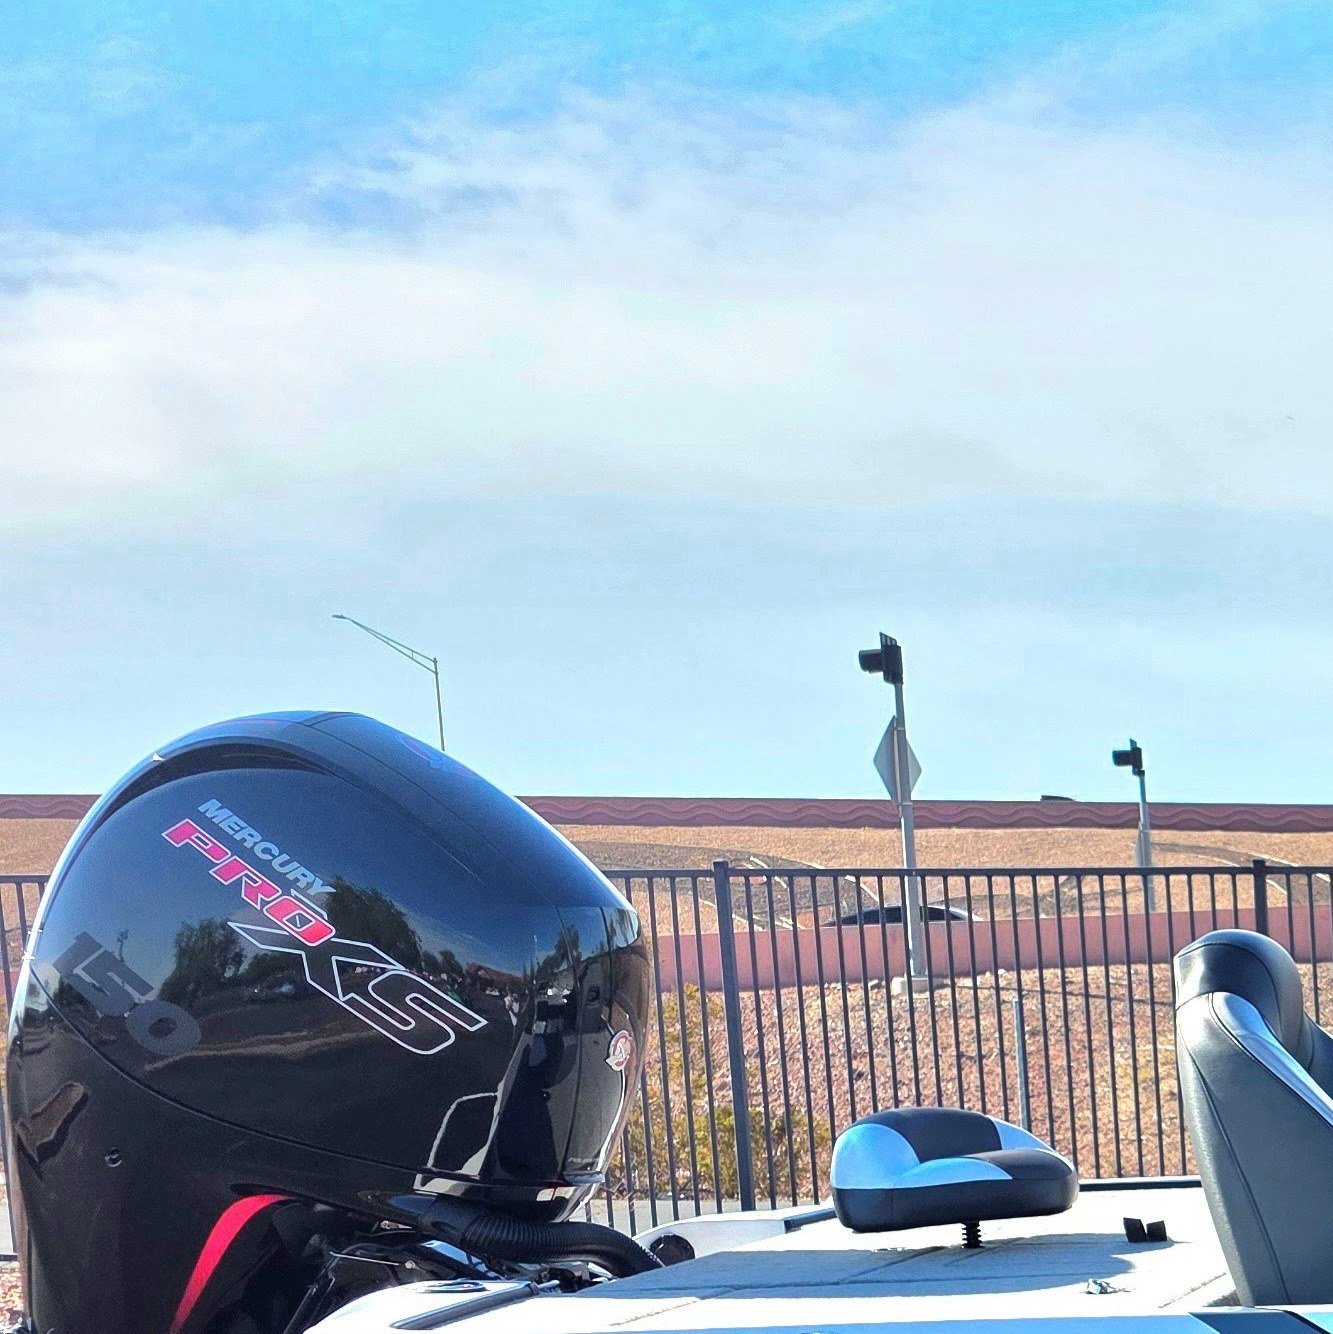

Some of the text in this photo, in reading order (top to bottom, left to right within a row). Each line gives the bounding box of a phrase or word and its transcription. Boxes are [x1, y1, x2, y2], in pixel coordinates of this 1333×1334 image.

[161, 818, 336, 946] PRO
[198, 798, 337, 897] MERCURY
[52, 931, 202, 1056] 150
[227, 888, 488, 1055] XS
